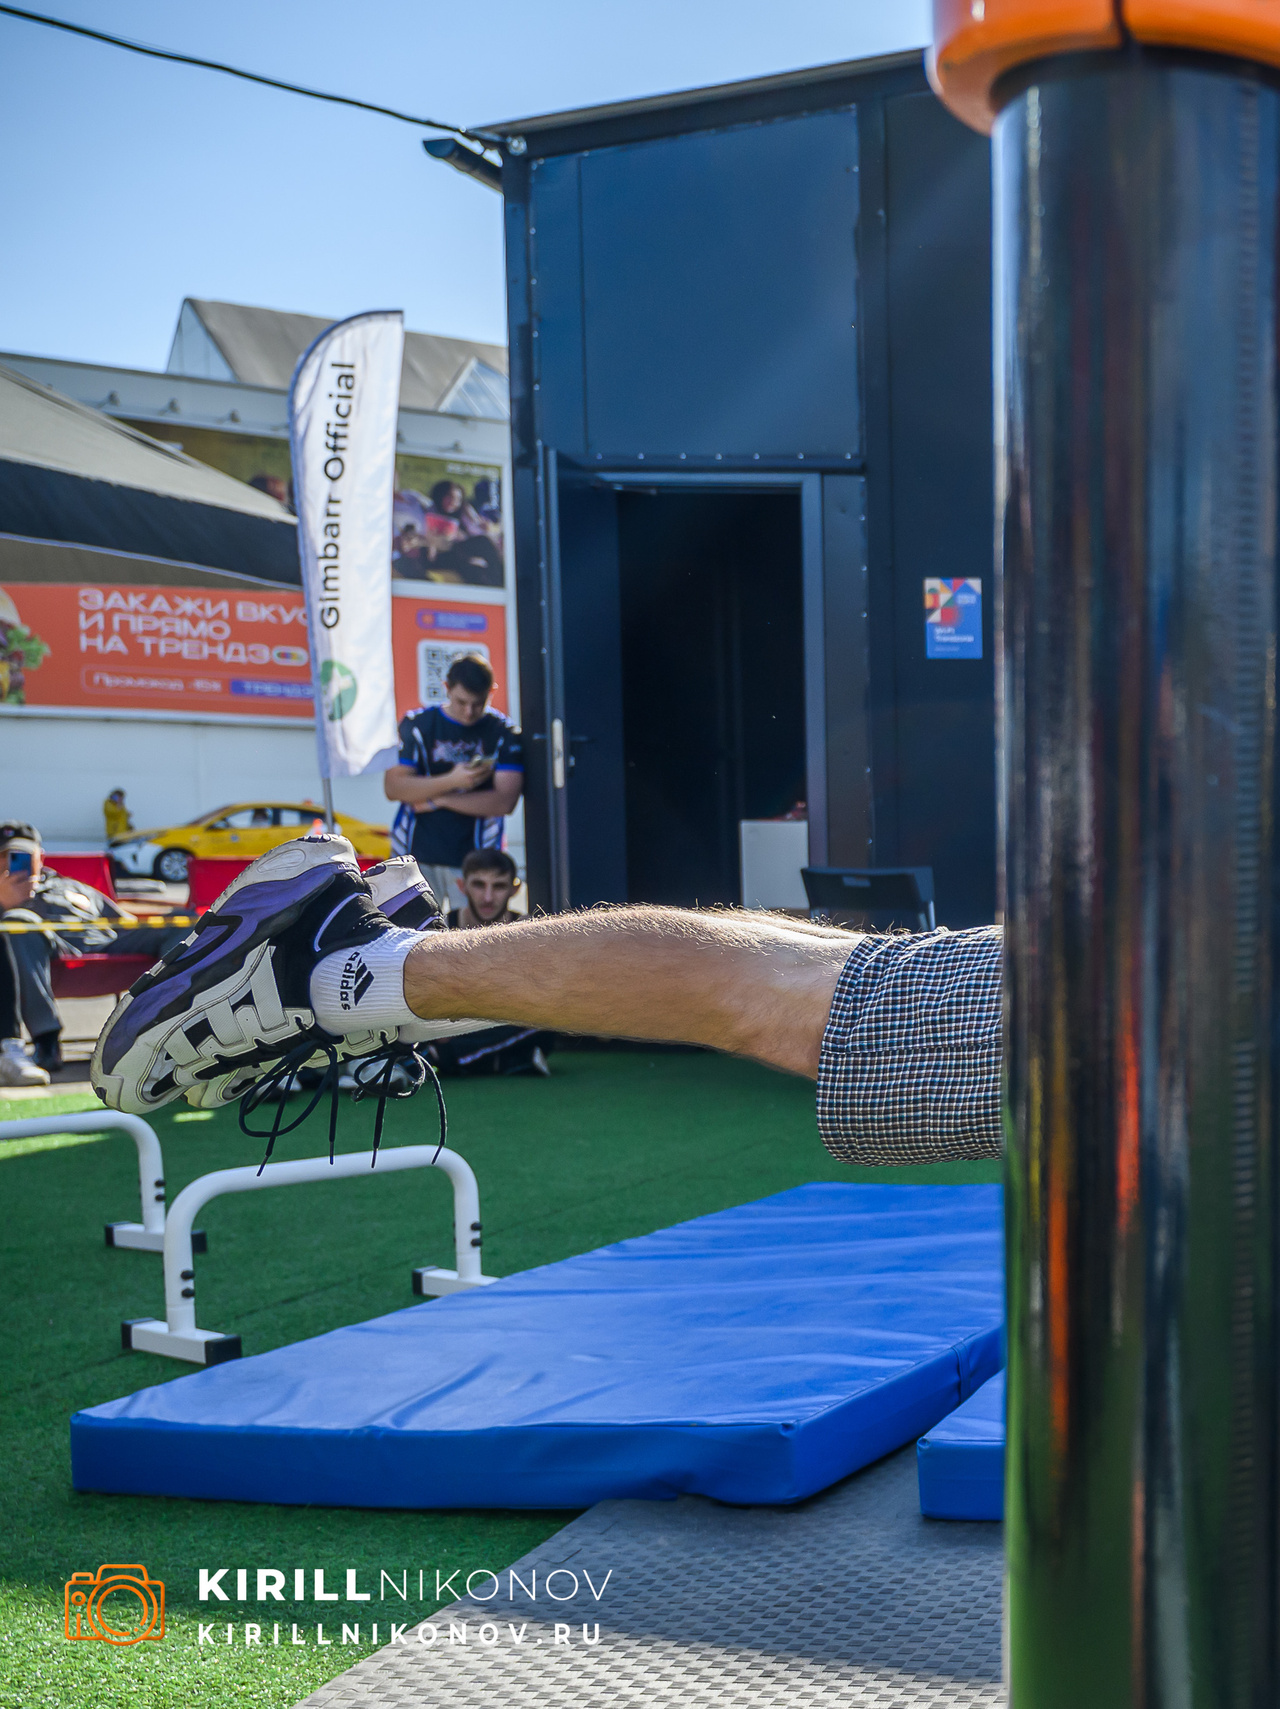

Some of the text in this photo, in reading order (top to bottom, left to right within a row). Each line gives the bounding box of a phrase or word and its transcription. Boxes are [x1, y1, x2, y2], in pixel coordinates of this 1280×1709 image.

[317, 363, 355, 630] Gimbarr Official
[78, 588, 230, 620] ЗАКАЖИ
[79, 611, 232, 641] И ПРЯМО
[79, 632, 129, 655] НА
[340, 951, 361, 1011] adidas
